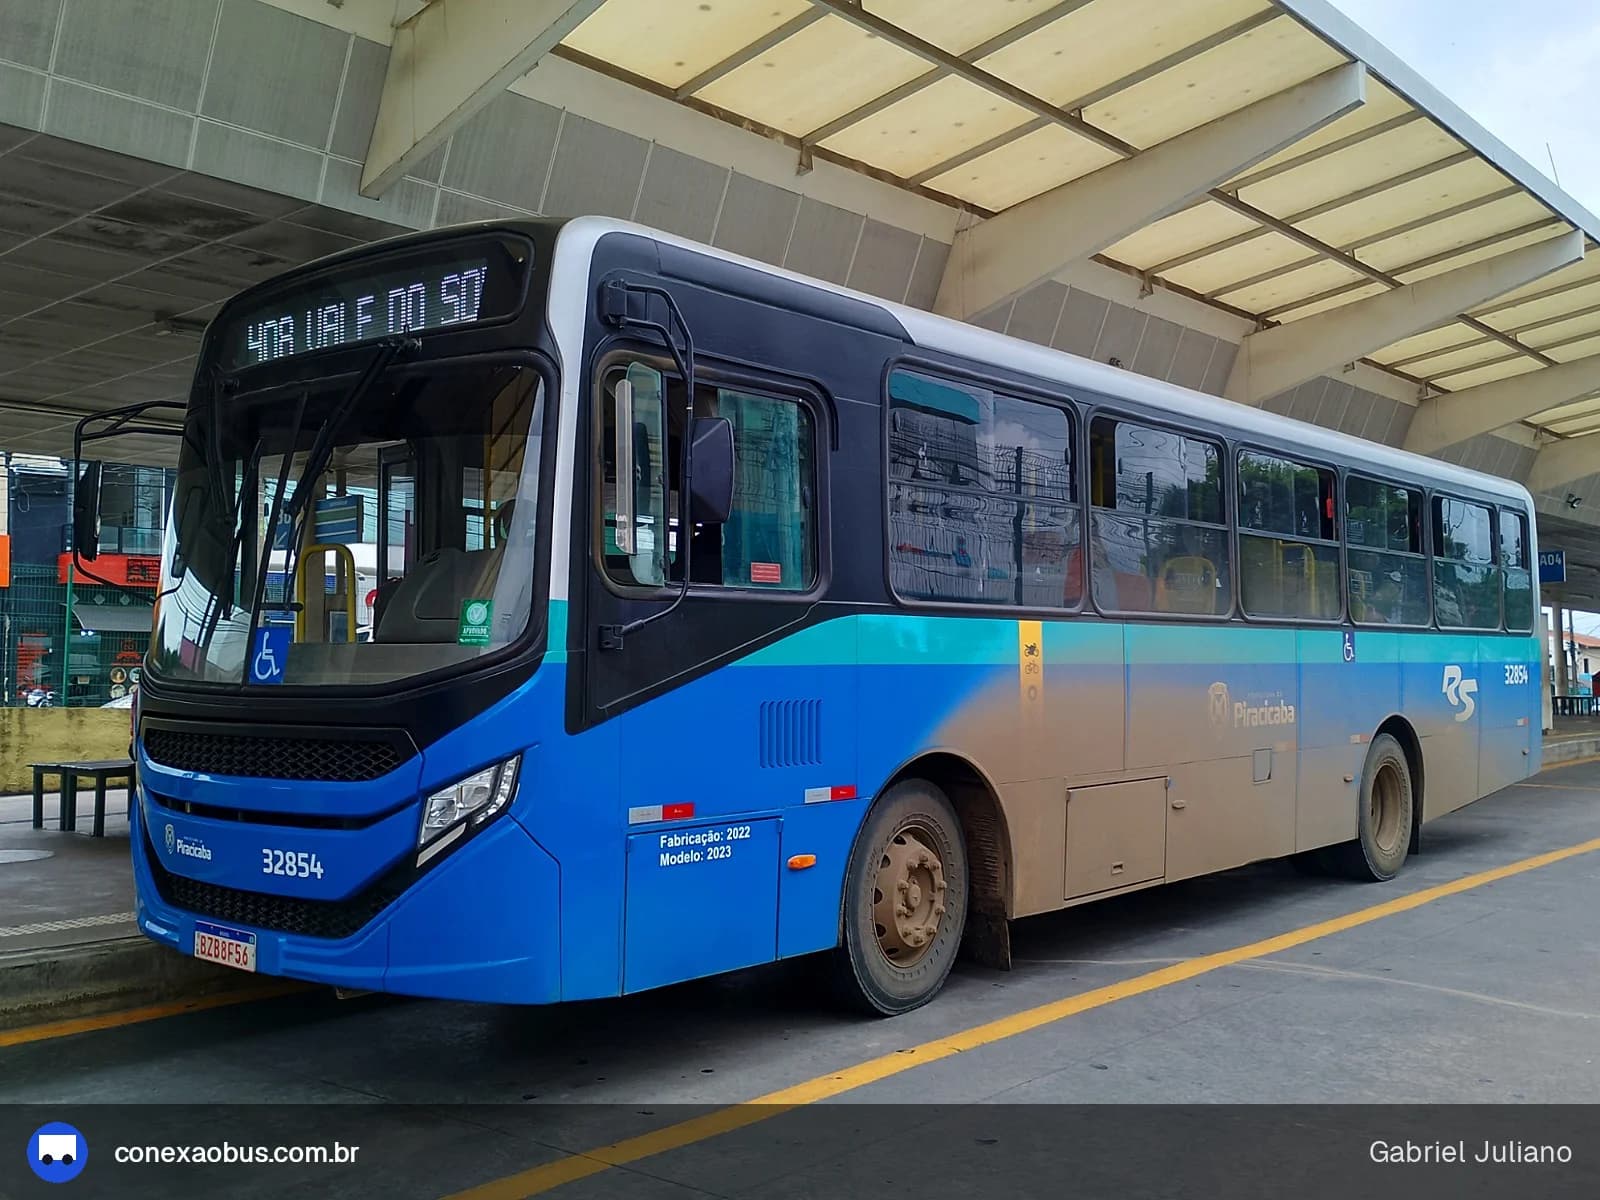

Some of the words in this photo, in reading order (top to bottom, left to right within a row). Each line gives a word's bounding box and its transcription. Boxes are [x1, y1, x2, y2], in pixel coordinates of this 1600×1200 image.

[1540, 553, 1562, 567] A04
[1504, 664, 1529, 685] 32854
[1234, 699, 1295, 728] Piracicaba
[660, 830, 724, 849] Fabricação:
[727, 825, 751, 841] 2022
[177, 839, 212, 861] Piracicaba
[660, 849, 704, 867] Modelo:
[707, 845, 732, 861] 2023
[262, 848, 324, 880] 32854
[200, 935, 249, 966] BZB8F56
